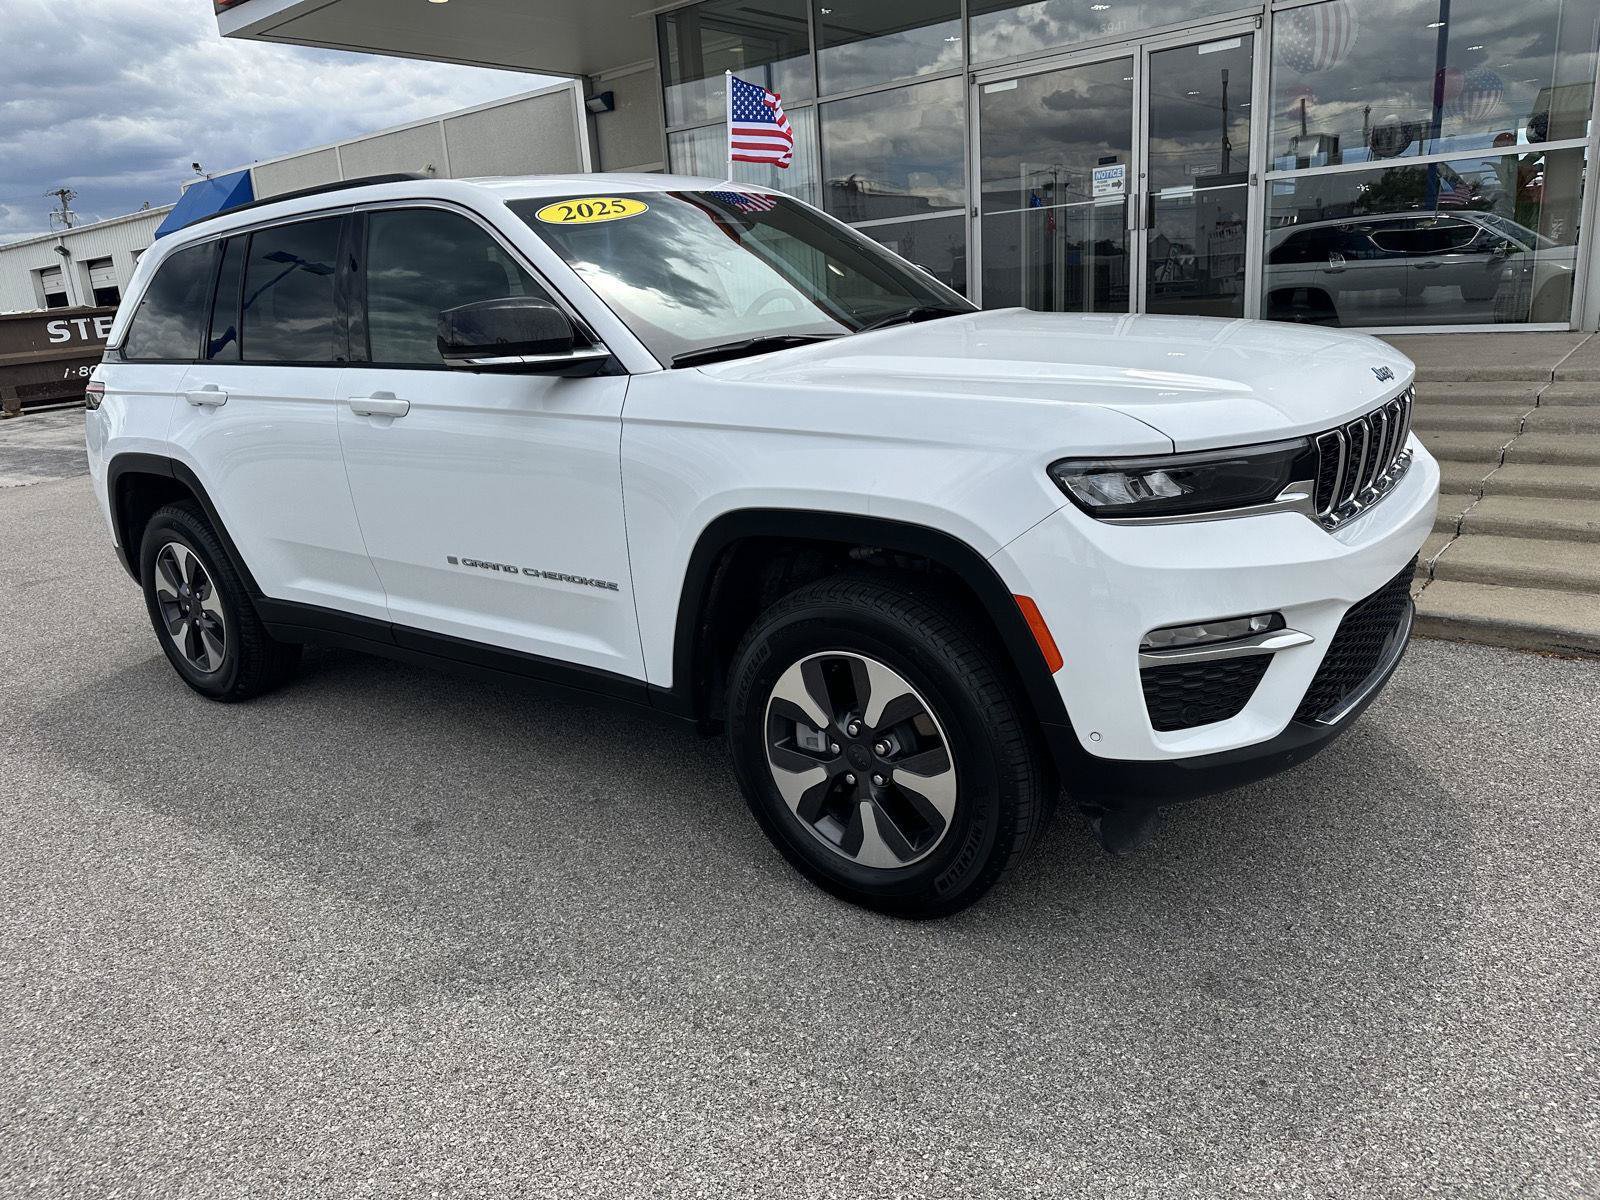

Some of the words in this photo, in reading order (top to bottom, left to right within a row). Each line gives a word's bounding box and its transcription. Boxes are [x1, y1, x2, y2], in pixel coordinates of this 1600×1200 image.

[1095, 168, 1122, 180] NOTICE
[558, 200, 627, 221] 2025
[46, 315, 114, 343] STE
[1370, 366, 1395, 382] Jeep
[461, 557, 519, 575] GRAND
[522, 567, 620, 592] CHEROKEE
[934, 822, 984, 892] MICHELIN
